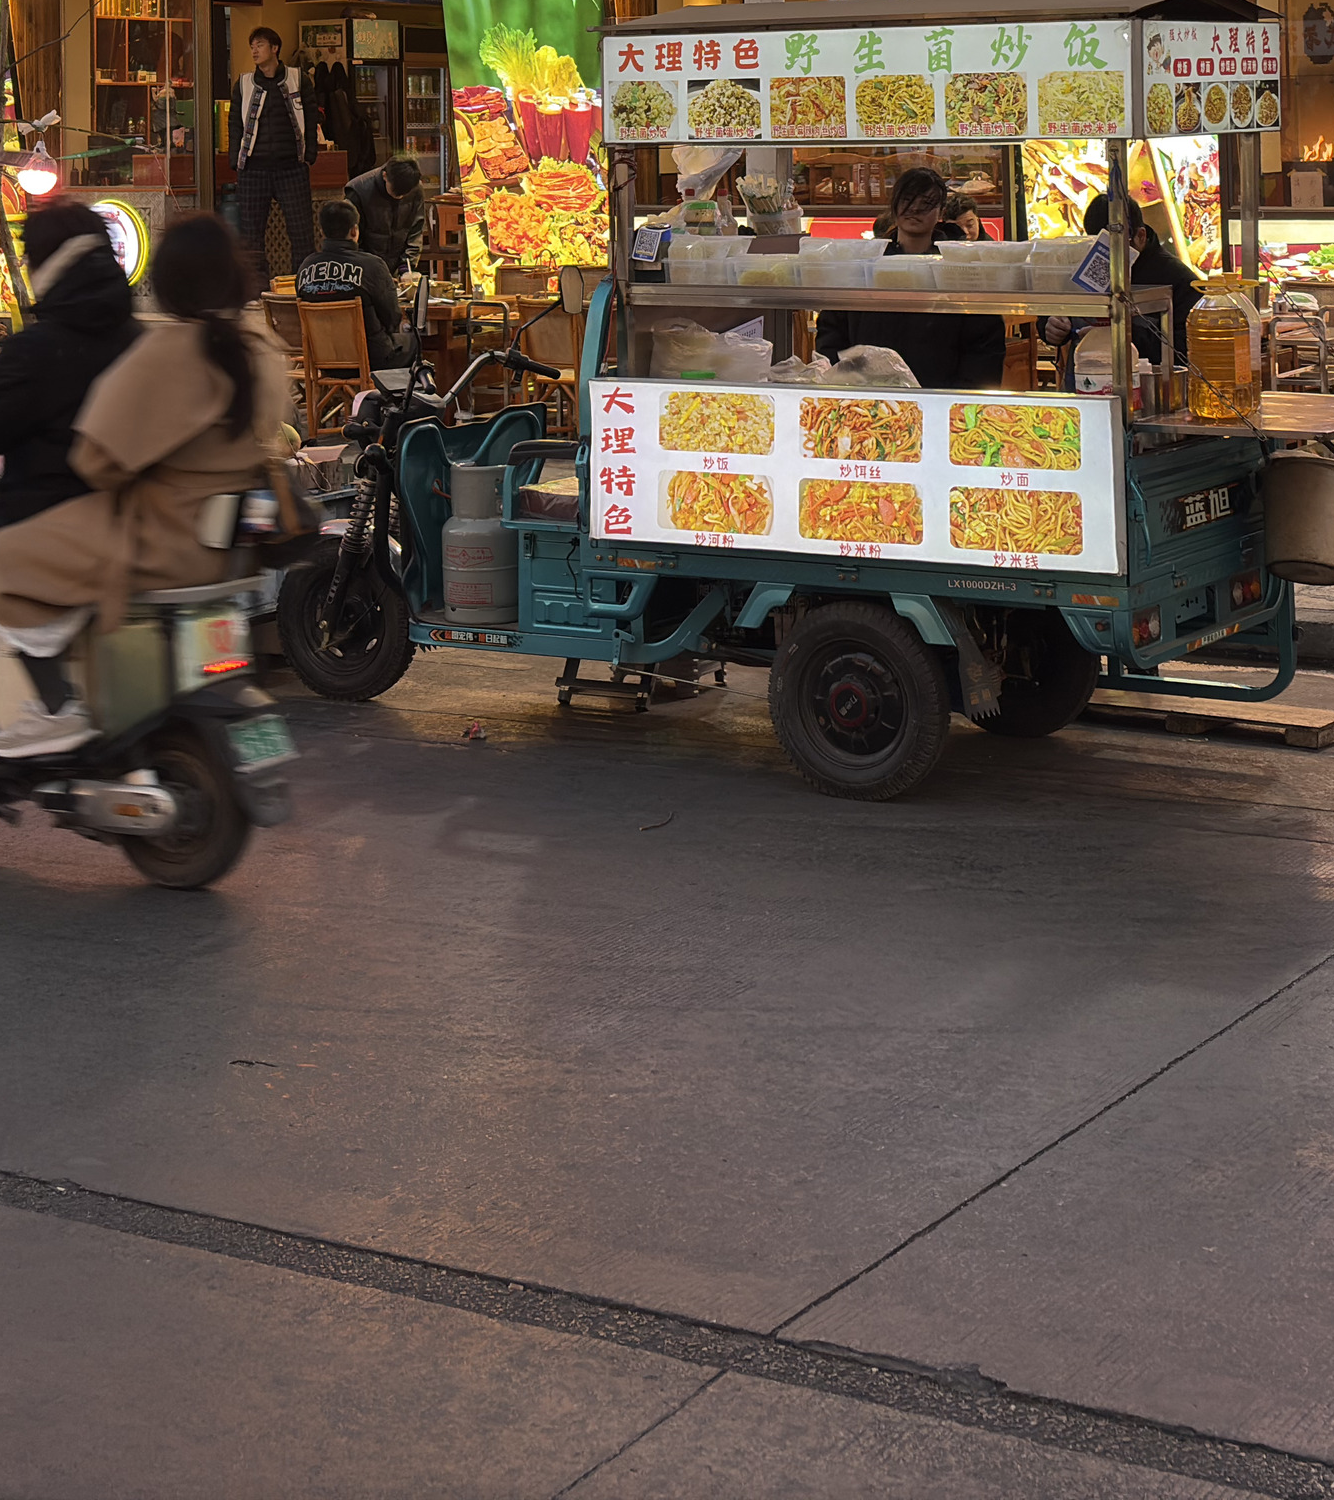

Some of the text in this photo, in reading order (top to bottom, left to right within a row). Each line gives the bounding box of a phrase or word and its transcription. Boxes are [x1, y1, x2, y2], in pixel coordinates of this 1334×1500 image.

[617, 21, 1109, 75] 大理特色 野生菌炒饭
[1210, 24, 1271, 55] 大理特色
[618, 126, 668, 139] 野生菌炒饭
[958, 123, 1016, 135] 野生菌炒面
[1047, 122, 1118, 134] 野生菌炒米粉
[599, 386, 637, 536] 大理特色
[702, 455, 1029, 488] 炒饭 炒饵丝 炒面
[694, 532, 1040, 569] 炒河粉 炒米粉 炒米线
[947, 578, 1017, 592] LX1000DZH-3
